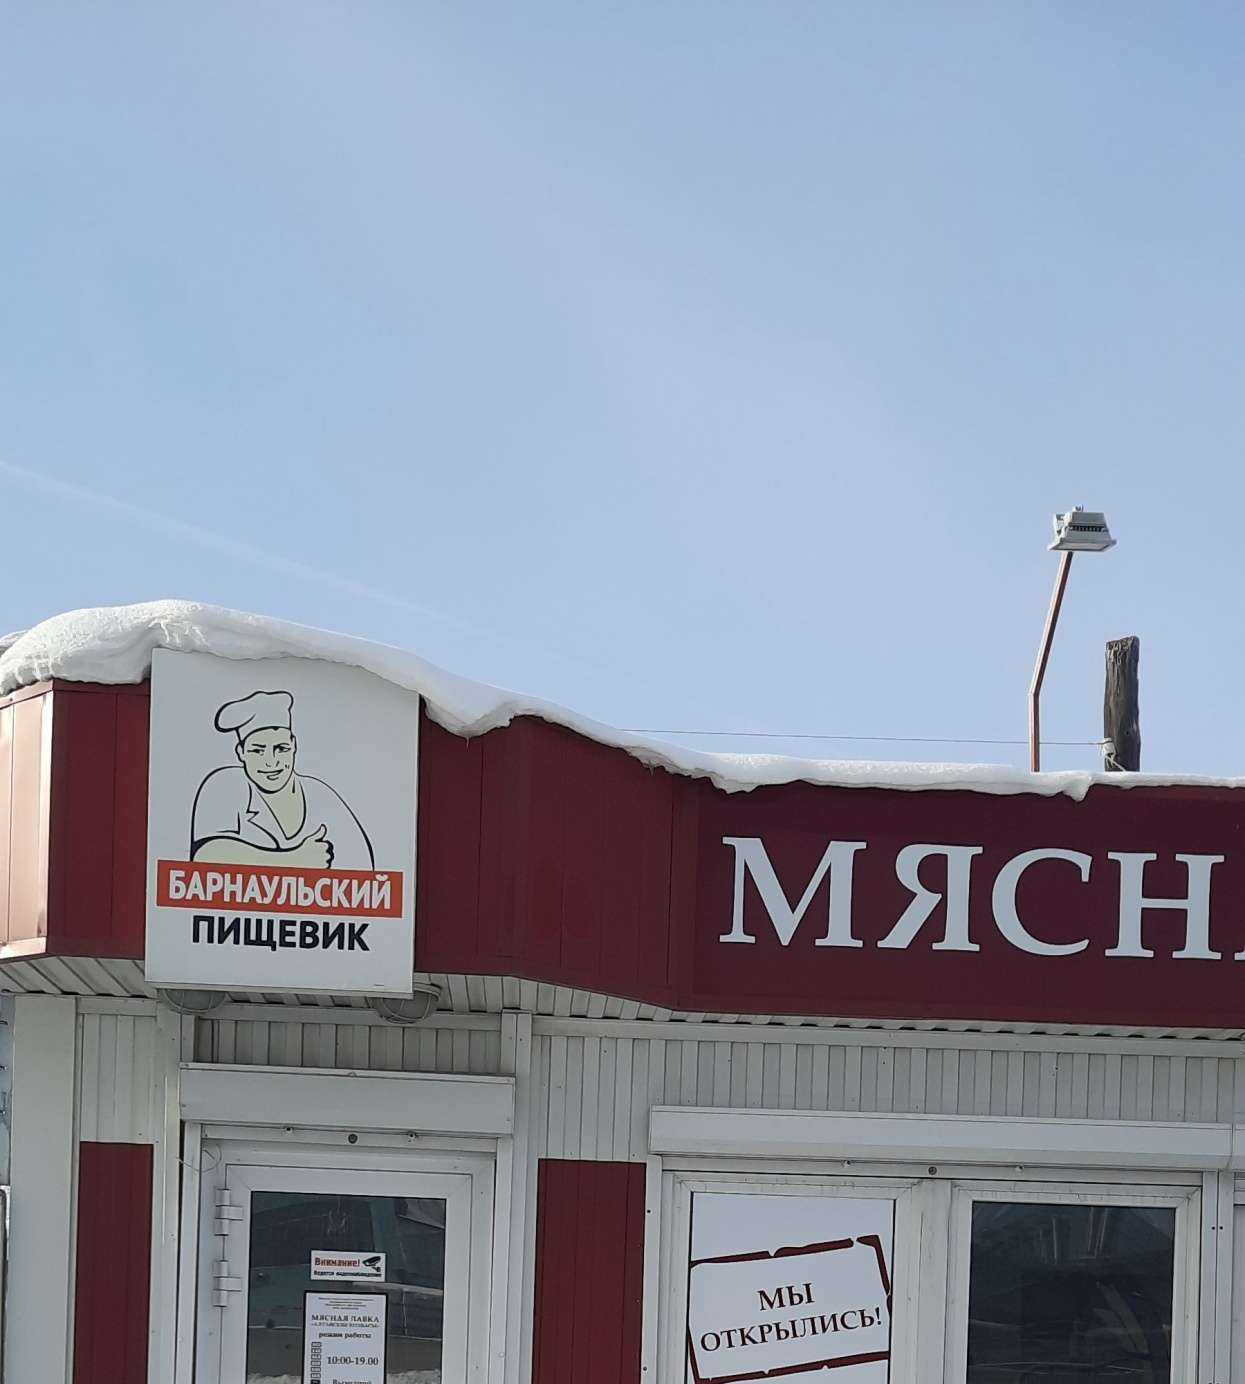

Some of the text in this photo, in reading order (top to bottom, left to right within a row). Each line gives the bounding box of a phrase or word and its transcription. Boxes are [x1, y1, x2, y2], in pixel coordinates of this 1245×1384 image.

[168, 869, 392, 910] БАРНАУЛЬСКИЙ
[719, 836, 1245, 961] МЯСН
[191, 914, 371, 952] ПИЩЕВИК
[314, 1256, 361, 1268] Внимание!
[757, 1282, 816, 1312] МЫ
[311, 1314, 380, 1323] МЯСНАЯ ЛАВКА
[344, 1331, 372, 1340] работы
[700, 1306, 882, 1352] ОТКРЫЛИСЬ!
